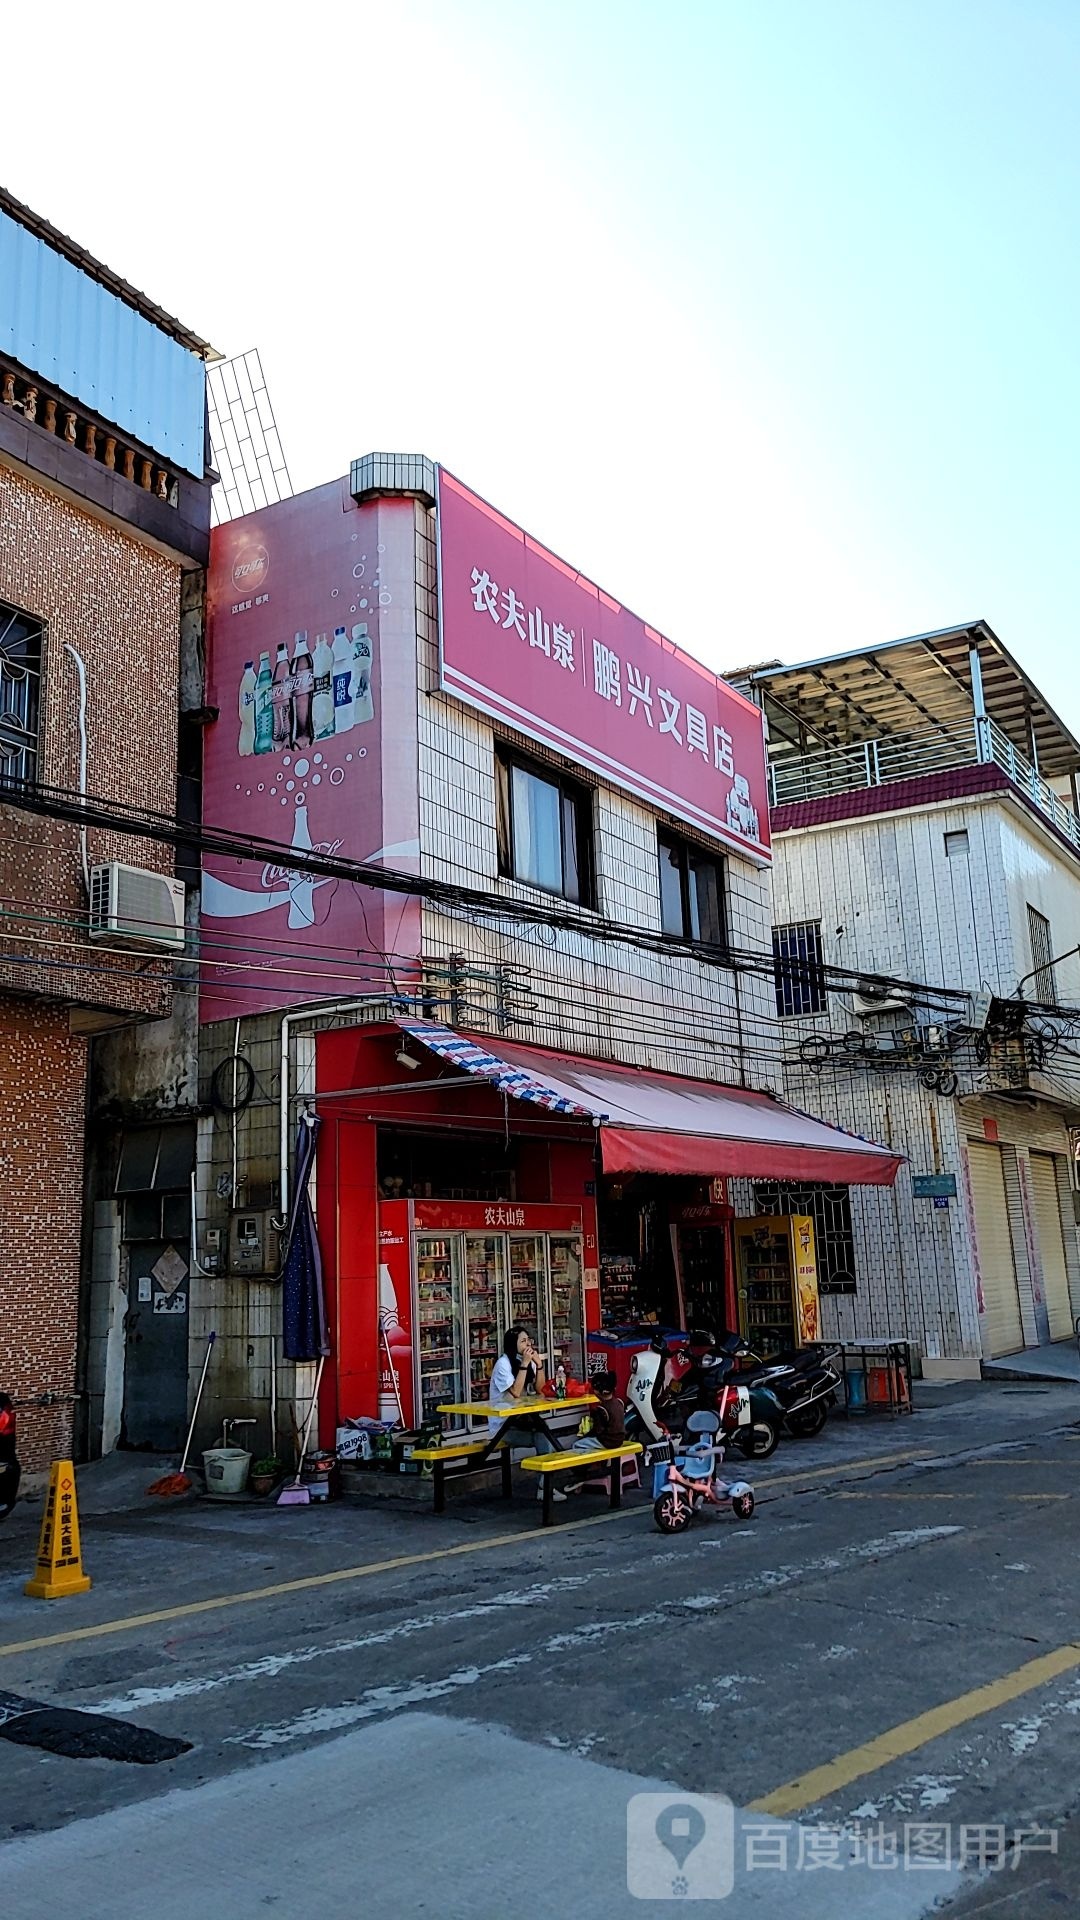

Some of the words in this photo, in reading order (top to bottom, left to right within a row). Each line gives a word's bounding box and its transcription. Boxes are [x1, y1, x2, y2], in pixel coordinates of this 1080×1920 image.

[470, 566, 576, 673] 农夫山泉
[592, 638, 735, 779] 鹏兴文具店
[484, 1206, 525, 1226] 农夫山泉
[61, 1493, 72, 1556] 中山医大医院
